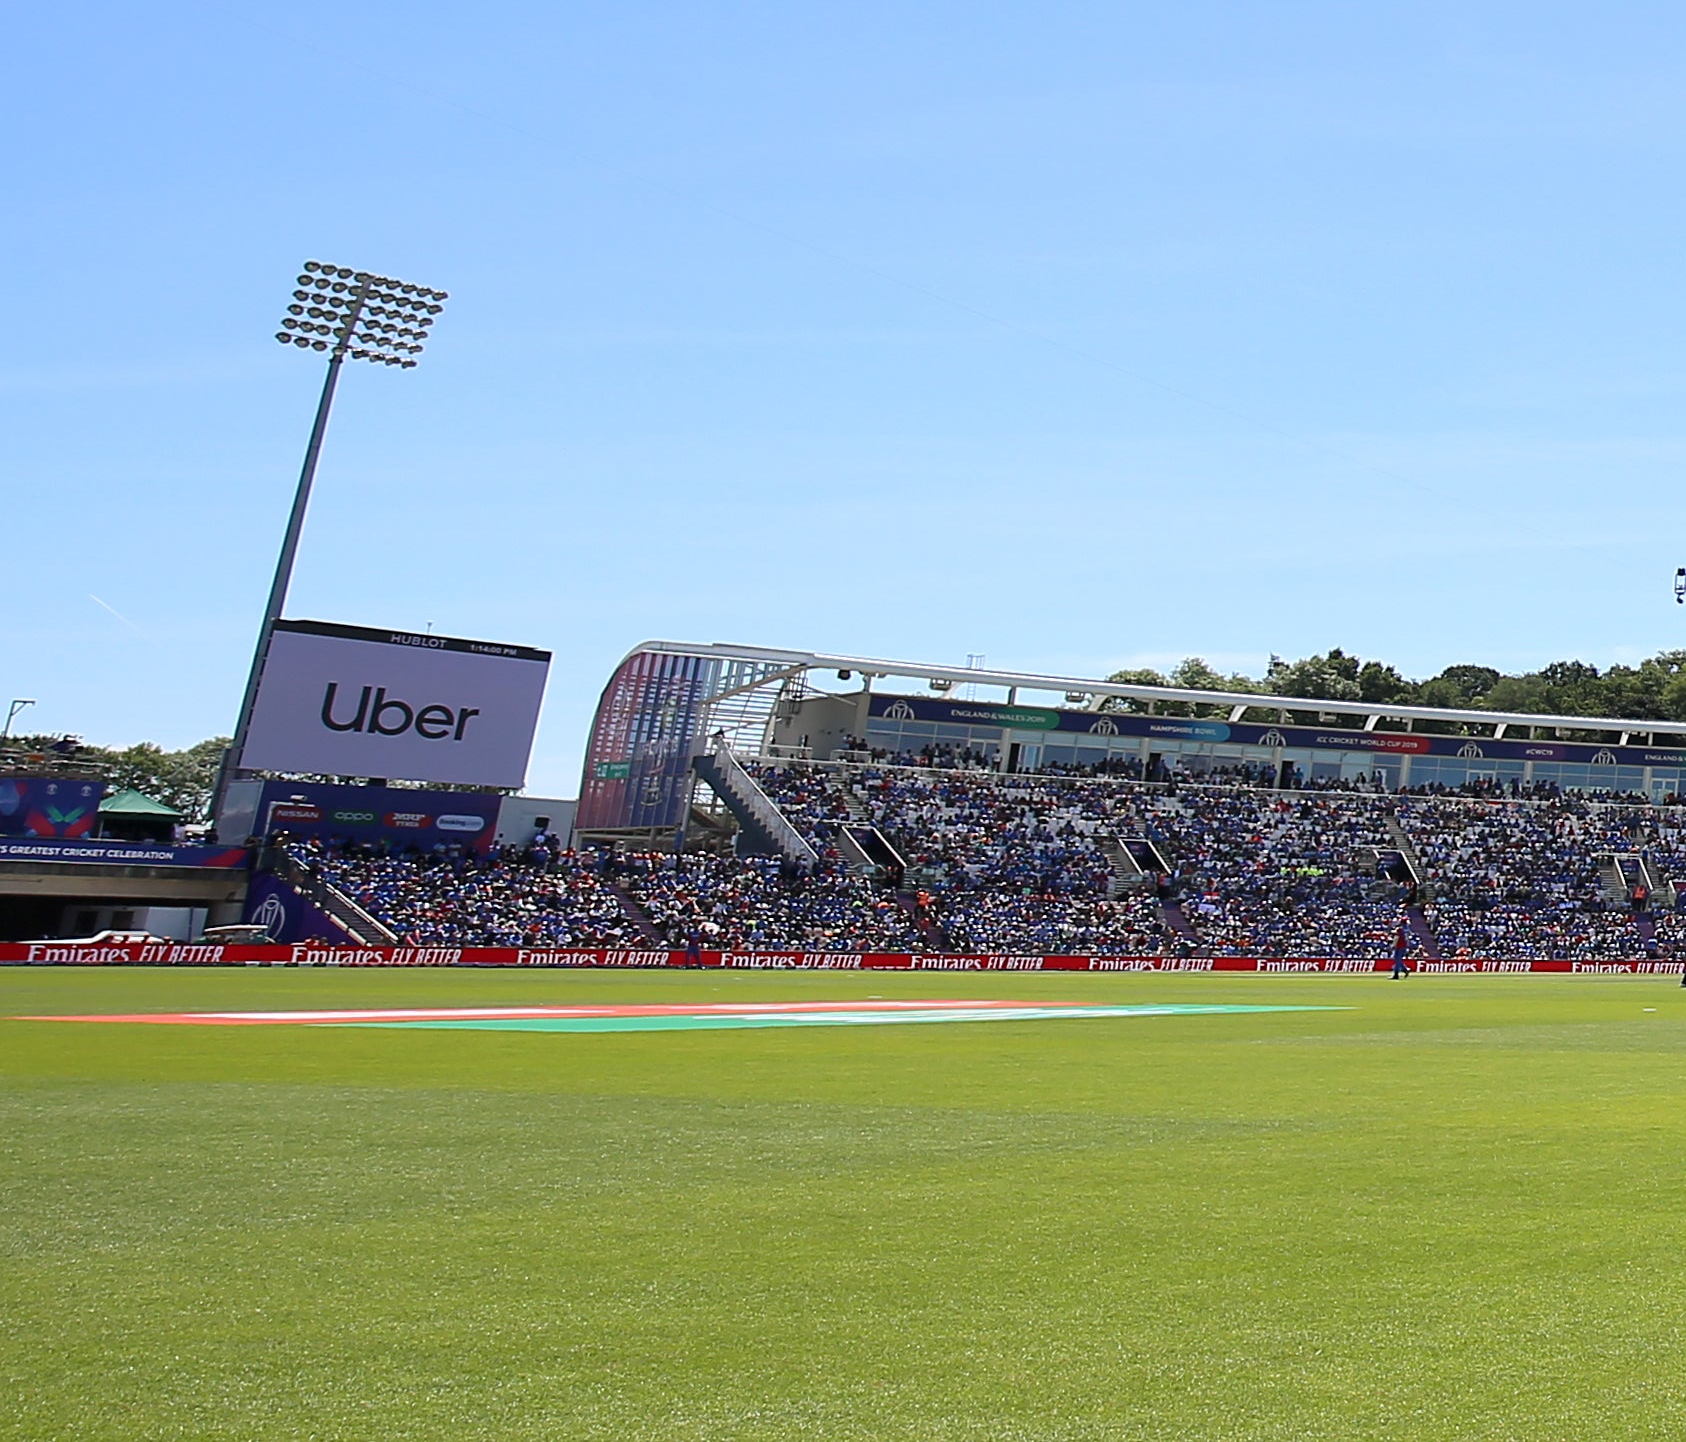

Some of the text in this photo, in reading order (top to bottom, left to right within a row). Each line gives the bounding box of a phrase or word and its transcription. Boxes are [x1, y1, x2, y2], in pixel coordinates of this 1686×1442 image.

[391, 634, 448, 648] HUBLOT
[503, 648, 517, 656] PM
[321, 682, 480, 741] Uber
[951, 709, 990, 721] ENGLAND
[1150, 725, 1217, 736] HAMPSHIRE BOWL
[1331, 737, 1358, 746] CRICKET
[1360, 739, 1385, 747] WORLD
[277, 810, 319, 819] NISSAN
[335, 812, 373, 822] oppo
[10, 845, 174, 860] GREATEST CRICKET CELEBRATION
[28, 945, 130, 963] Emirates
[171, 945, 224, 963] BETTER
[292, 946, 387, 964] Emirates
[416, 946, 462, 964] BETTER
[517, 949, 597, 965] Emirates
[627, 949, 669, 965] BETTER
[720, 952, 796, 967] Emirates
[823, 952, 862, 967] BETTER
[910, 955, 981, 970] Emirates
[1007, 955, 1044, 970] BETTER
[1089, 957, 1154, 971] Emirates
[1178, 957, 1214, 971] BETTER
[1256, 959, 1319, 972] Emirates
[1341, 959, 1376, 972] BETTER
[1416, 959, 1476, 973] Emirates
[1500, 959, 1532, 973] BETTER
[1572, 960, 1631, 974] Emirates
